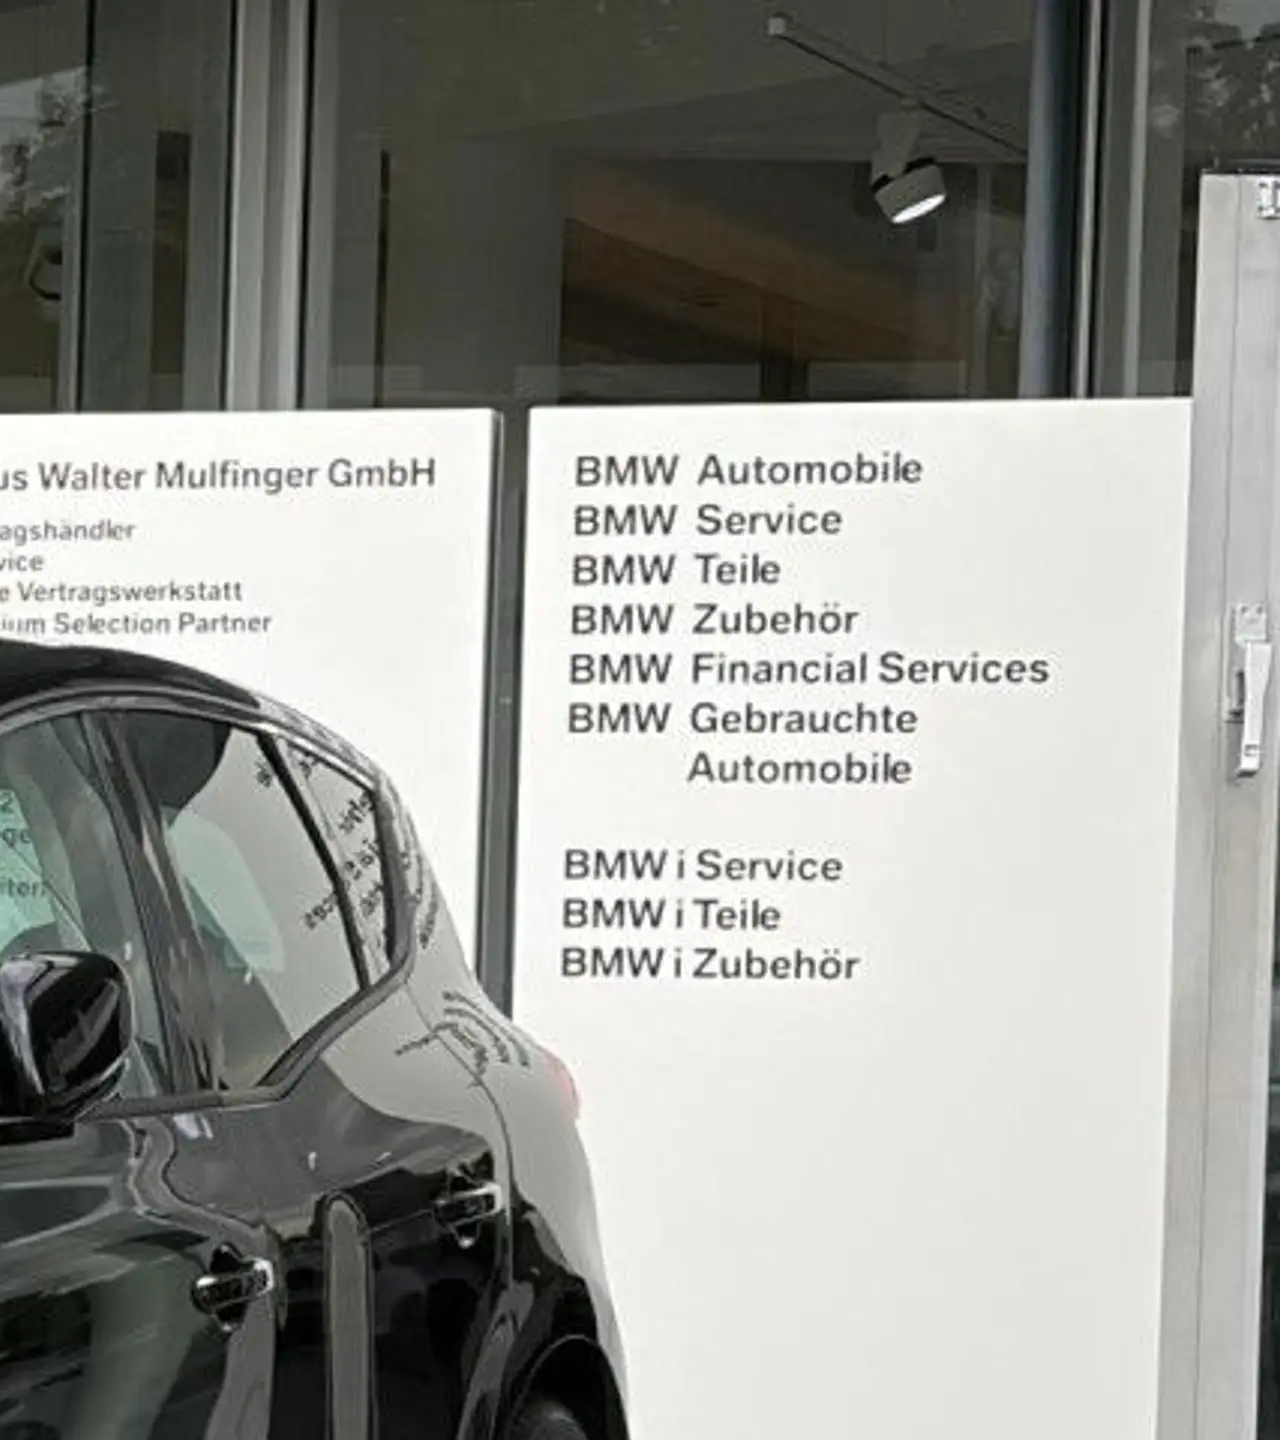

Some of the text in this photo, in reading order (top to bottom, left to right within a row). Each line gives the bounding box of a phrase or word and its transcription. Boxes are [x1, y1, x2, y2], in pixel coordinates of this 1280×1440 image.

[38, 461, 146, 491] Walter
[155, 459, 319, 496] Mulfinger
[327, 457, 436, 488] GmbH
[575, 451, 923, 487] BMW Automobile
[574, 503, 843, 537] BMW Service
[572, 552, 781, 587] BMW Teile
[17, 580, 243, 607] Vertragswerkstatt
[54, 612, 170, 635] Selection
[178, 611, 272, 634] Partner
[571, 602, 860, 636] BMW Zubehör
[569, 650, 1050, 685] BMW Financial Services
[568, 701, 919, 735] BMW Gebrauchte
[686, 751, 913, 785] Automobile
[564, 848, 844, 882] BMW i Service
[562, 897, 781, 931] BMW i Teile
[561, 946, 861, 981] BMW i Zubehör
